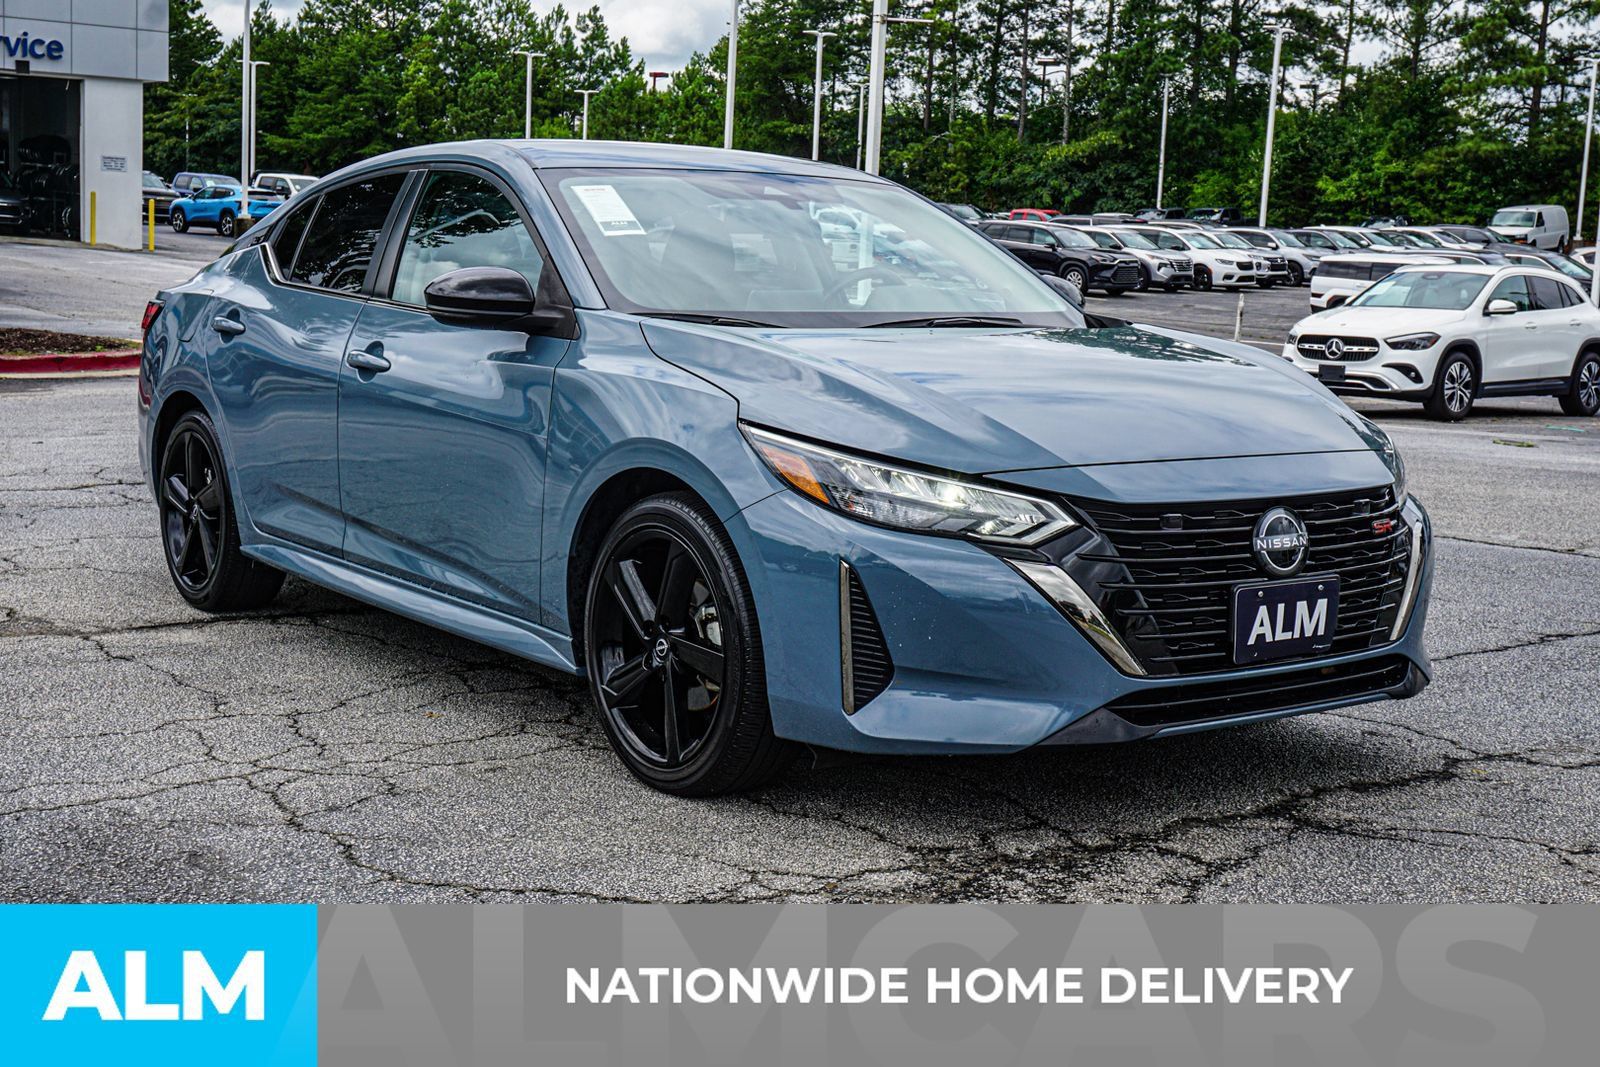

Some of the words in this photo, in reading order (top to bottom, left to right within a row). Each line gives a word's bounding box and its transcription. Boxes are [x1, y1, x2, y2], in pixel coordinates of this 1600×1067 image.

[0, 31, 64, 60] vice
[1373, 519, 1393, 534] SR
[1257, 536, 1307, 549] NISSAN
[1247, 598, 1328, 645] ALM
